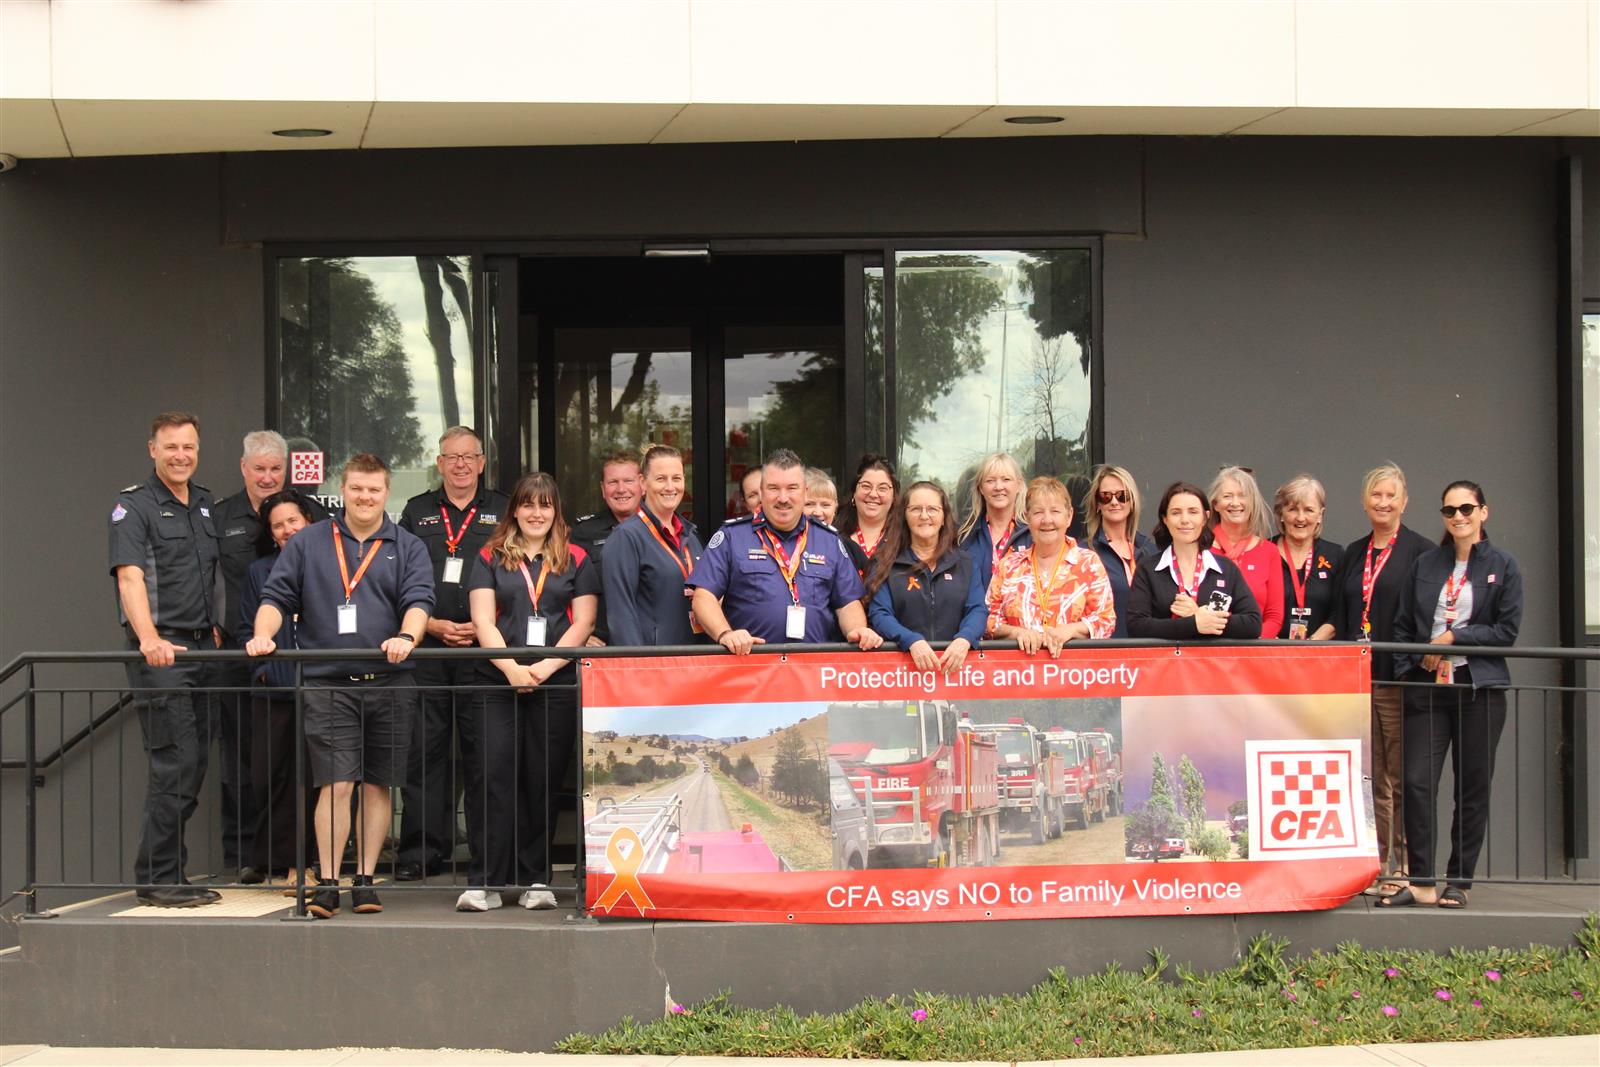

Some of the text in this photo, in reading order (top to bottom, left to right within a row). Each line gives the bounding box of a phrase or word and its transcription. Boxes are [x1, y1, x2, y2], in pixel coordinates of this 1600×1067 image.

[295, 471, 320, 481] CFA
[820, 663, 1139, 693] Protecting Life and Property
[878, 777, 910, 789] FIRE
[1270, 810, 1345, 842] CFA
[826, 878, 1242, 912] CFA says NO to Family Violence
